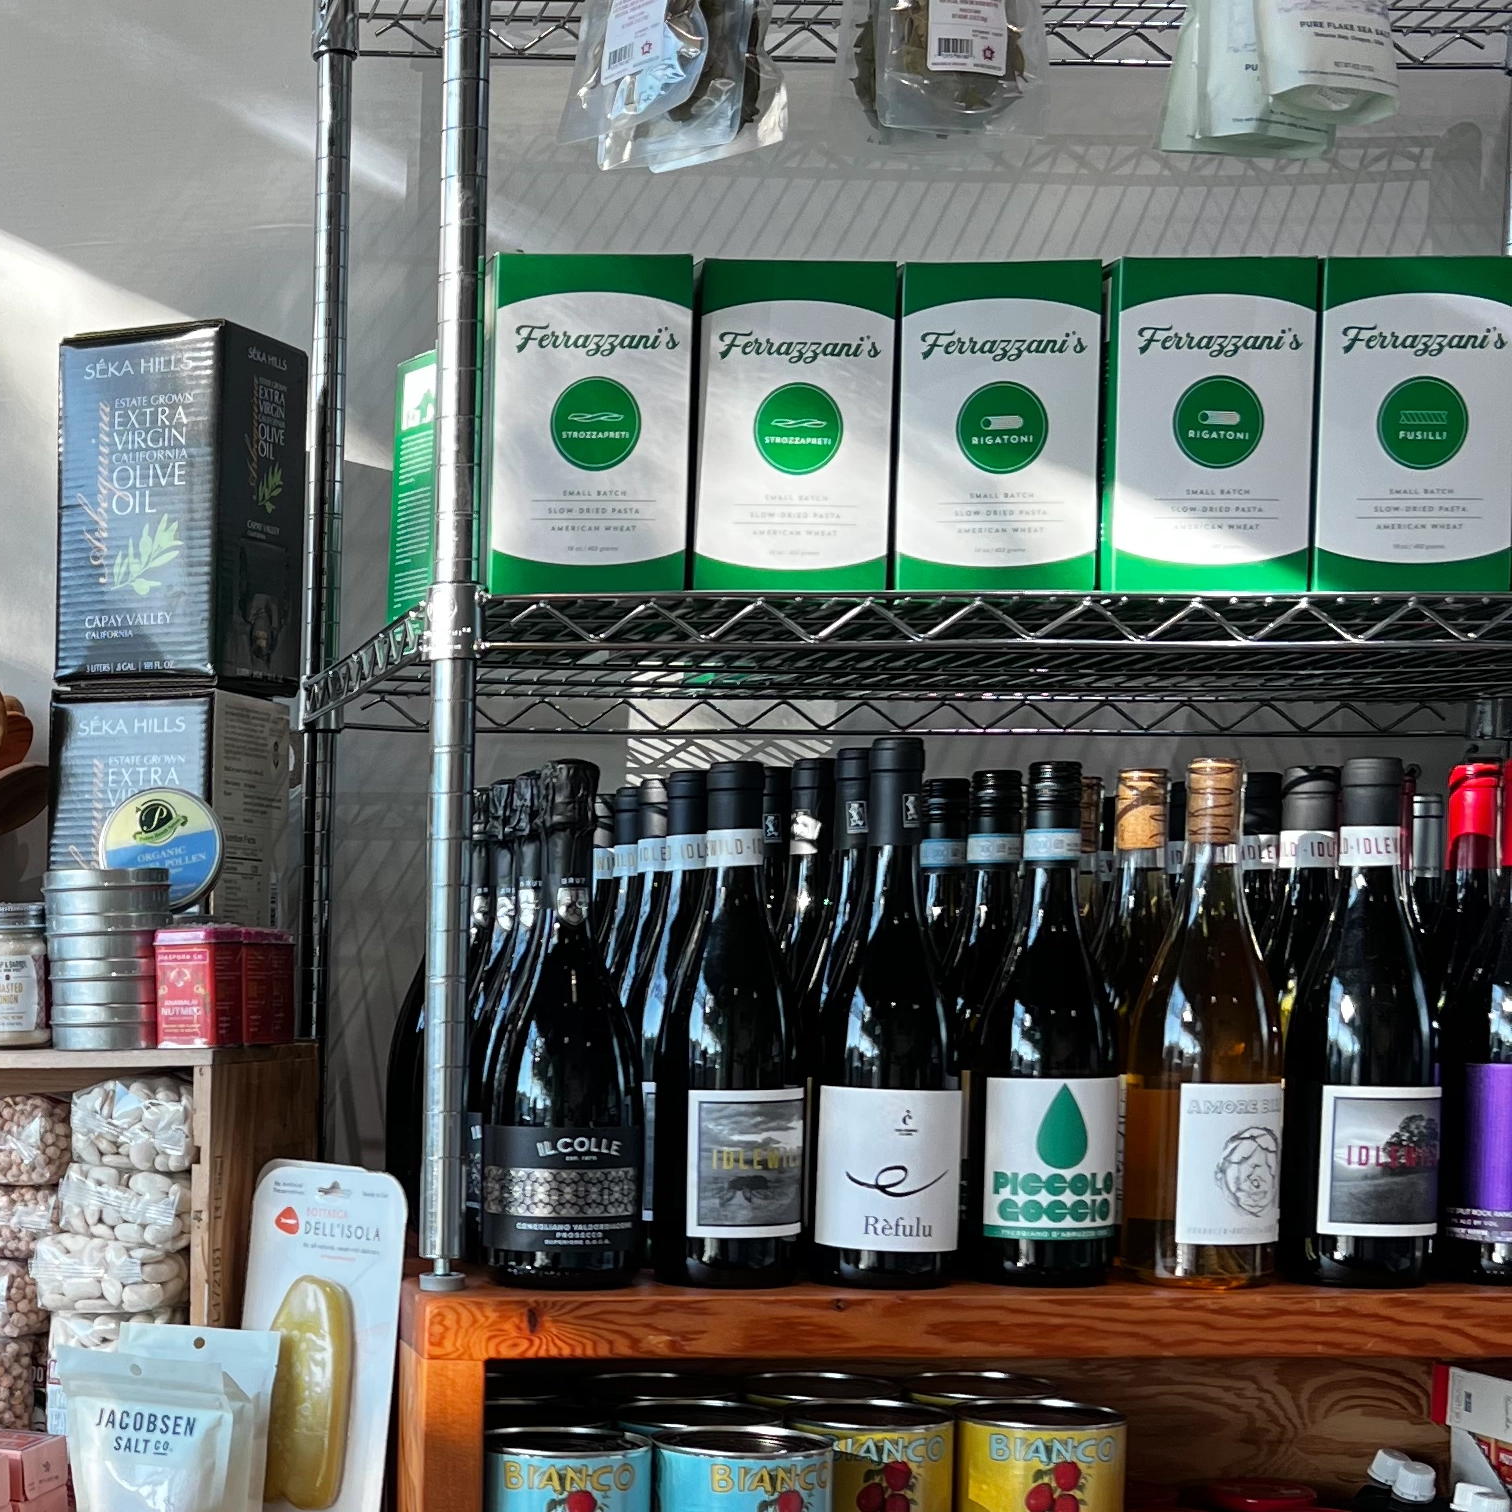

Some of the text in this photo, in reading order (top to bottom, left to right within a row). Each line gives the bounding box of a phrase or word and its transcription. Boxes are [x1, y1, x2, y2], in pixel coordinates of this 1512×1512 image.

[1300, 20, 1324, 28] PURE
[1327, 21, 1354, 31] FLAKE
[515, 324, 679, 357] Ferrazzani's
[719, 330, 881, 364] Ferrazzani's
[921, 329, 1087, 362] Ferrazzani's
[1138, 325, 1303, 358] Ferrazzani's
[1342, 325, 1507, 356] Ferrazzani's
[141, 354, 192, 374] HILLS
[115, 392, 193, 408] ESTATE GROWN
[114, 406, 188, 430] EXTRA
[113, 428, 187, 450] VIRGIN
[562, 430, 630, 439] STROZZAPRETI
[972, 435, 1033, 445] RIGATONI
[1188, 430, 1249, 440] RIGATONI
[1399, 431, 1447, 440] FUSILLI
[113, 448, 188, 464] CALIFORNIA
[112, 462, 186, 490] OLIVE
[112, 491, 156, 515] OIL
[85, 612, 173, 628] CAPAY VALLEY
[134, 717, 185, 733] HILLS
[108, 767, 180, 786] EXTRA
[137, 846, 185, 862] ORGANIC
[163, 852, 207, 869] POLLEN
[161, 1007, 201, 1016] NUTMEG
[1187, 1099, 1257, 1115] AMORE
[992, 1170, 1114, 1195] PICCOLO
[997, 1197, 1111, 1223] GOCCIO
[304, 1222, 381, 1242] DELL'ISOLA
[862, 1214, 934, 1239] Rèfulu
[95, 1408, 197, 1438] JACOBSEN
[114, 1436, 150, 1455] SALT
[989, 1434, 1116, 1464] BIANCO
[503, 1460, 635, 1493] BIANCO
